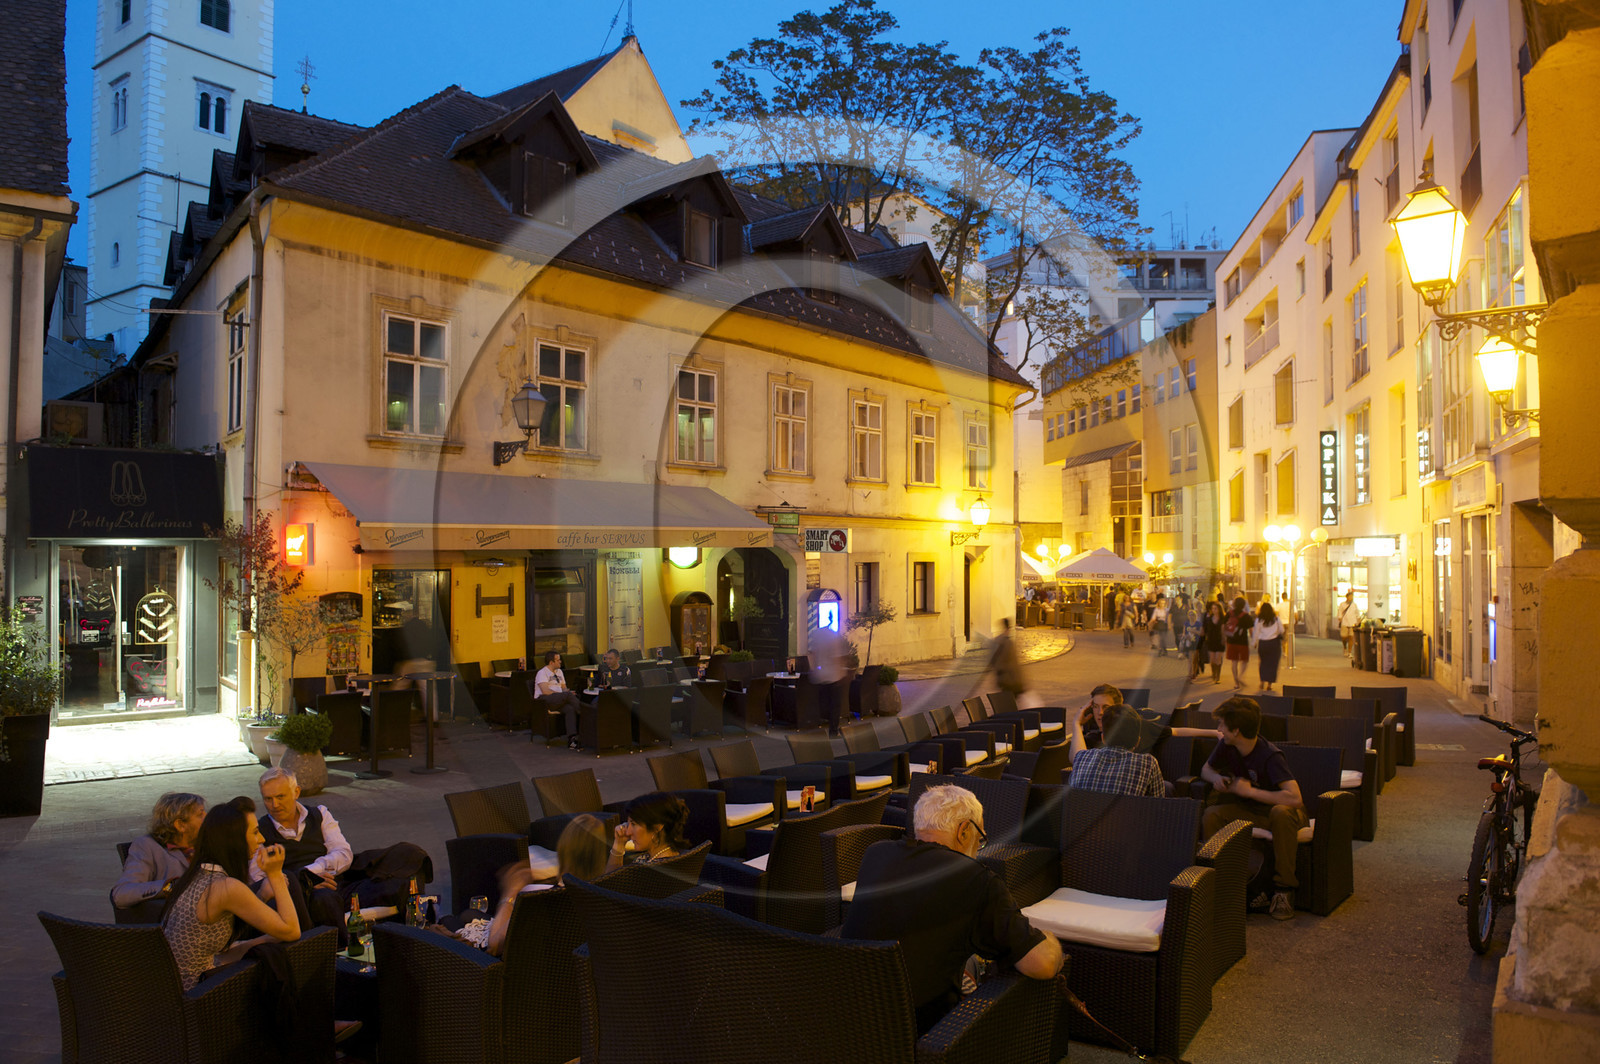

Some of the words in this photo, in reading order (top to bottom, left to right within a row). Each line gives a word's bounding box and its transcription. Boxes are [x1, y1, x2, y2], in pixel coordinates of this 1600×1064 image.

[1322, 433, 1336, 519] OPTIKA
[556, 531, 583, 548] caffe
[583, 531, 600, 544] bar
[601, 533, 646, 545] SERVUS
[805, 529, 829, 541] SMART
[805, 540, 824, 552] SHOP
